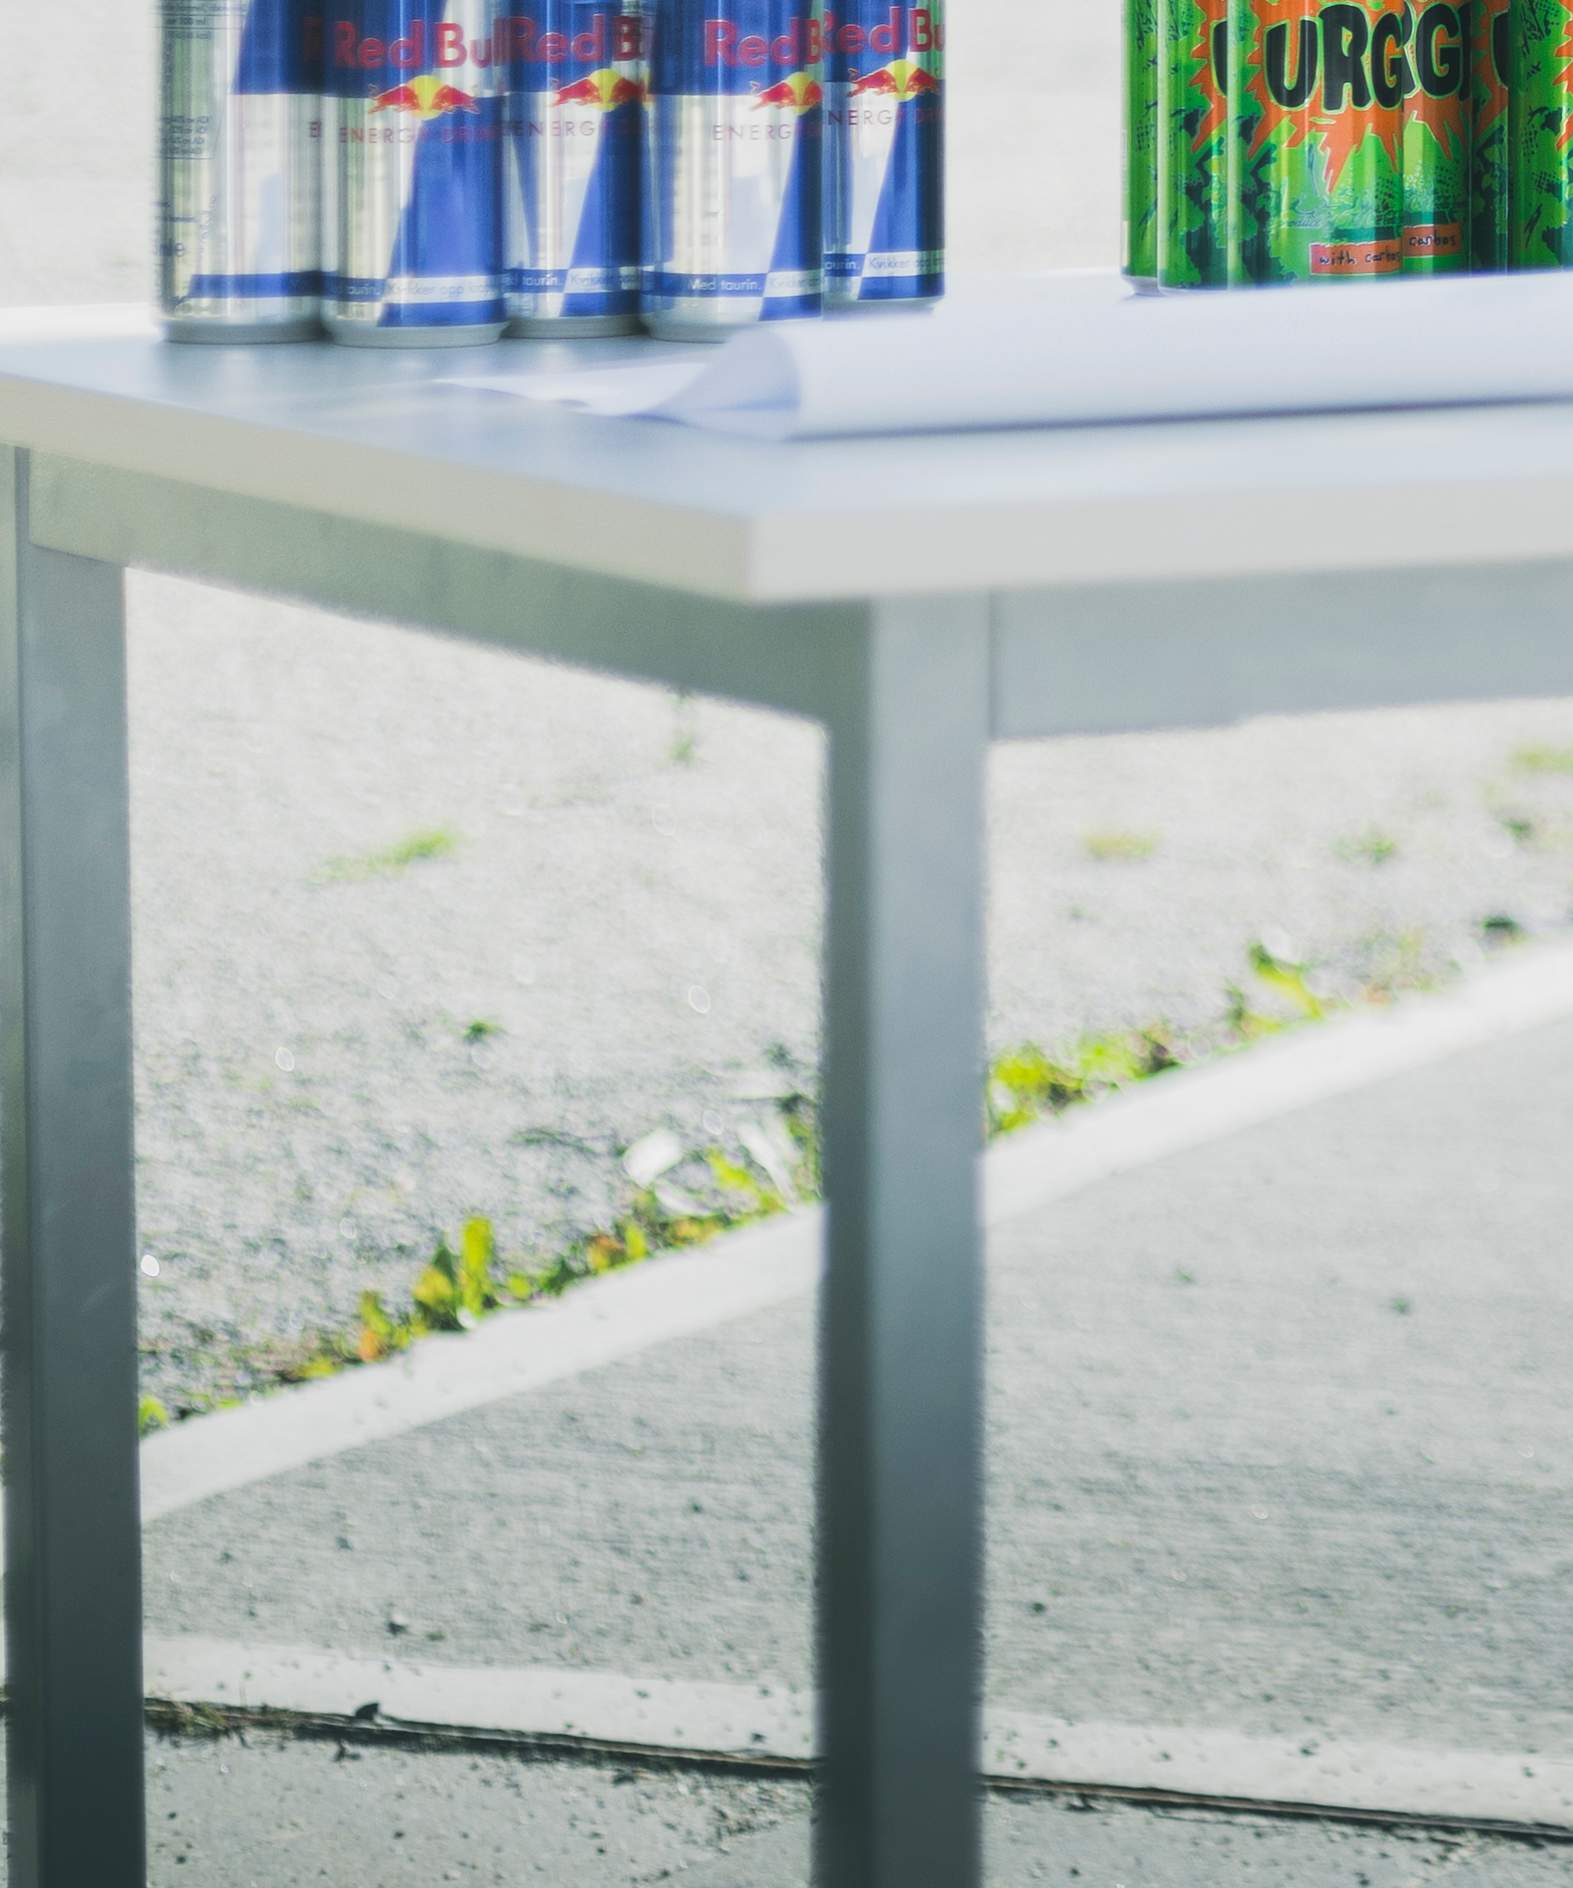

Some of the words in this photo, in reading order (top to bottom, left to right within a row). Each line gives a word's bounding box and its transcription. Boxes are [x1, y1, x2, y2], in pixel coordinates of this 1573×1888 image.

[333, 18, 426, 70] Red
[507, 14, 606, 64] Red
[704, 17, 802, 66] Red
[1265, 3, 1403, 112] URG
